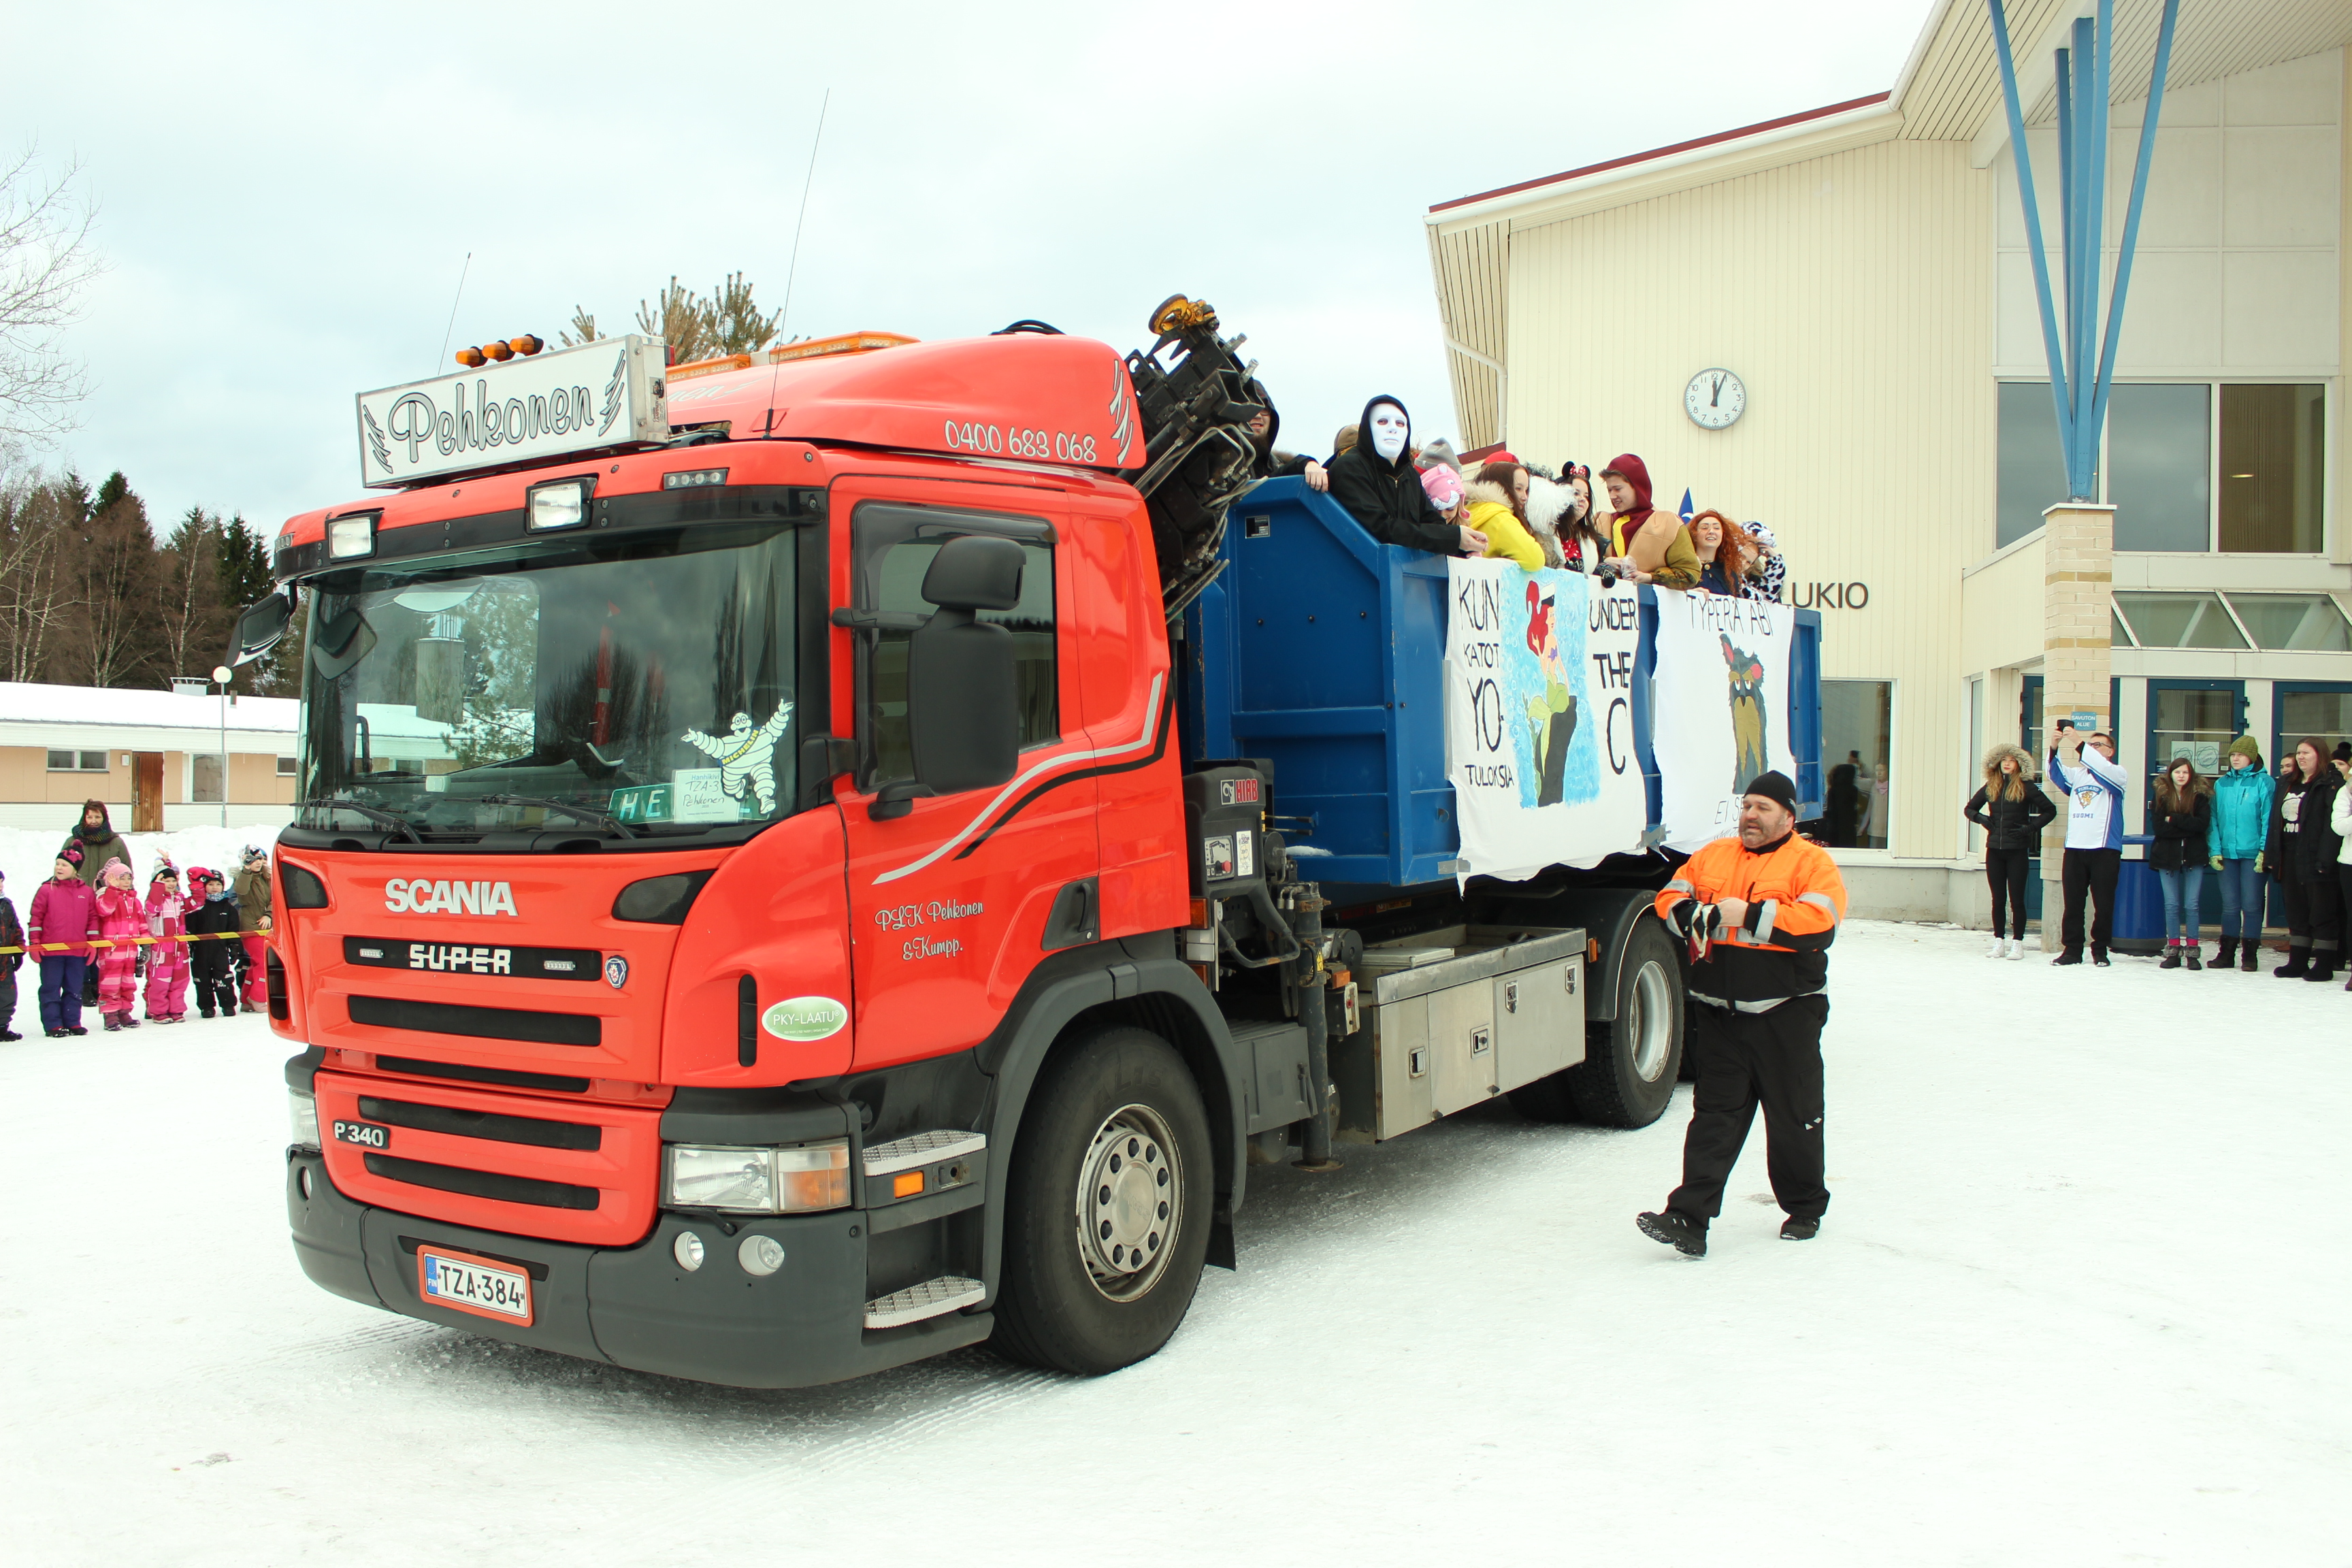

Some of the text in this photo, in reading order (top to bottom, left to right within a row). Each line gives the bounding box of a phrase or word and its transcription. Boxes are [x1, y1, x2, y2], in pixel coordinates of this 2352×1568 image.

[1692, 384, 1699, 392] 10
[1711, 372, 1718, 380] 12
[389, 380, 594, 463] Pehkonen
[1701, 414, 1708, 422] 7
[945, 419, 1097, 463] 0400 683 068
[1458, 575, 1499, 632] KUN
[1781, 582, 1869, 609] UKIO
[1588, 598, 1639, 632] UNDER
[1686, 594, 1774, 636] TYPERÄ ABI
[1463, 642, 1499, 668] KATOT
[1592, 651, 1631, 689] THE
[721, 729, 760, 765] MICHELIN
[1607, 697, 1627, 775] C
[685, 781, 719, 793] TZA-3
[1465, 764, 1514, 789] TULOKSIA
[619, 789, 665, 820] HE
[1235, 779, 1258, 804] HIAB
[1714, 800, 1729, 825] EI
[385, 879, 518, 916] SCANIA
[926, 898, 983, 923] Pehkonen
[410, 944, 511, 975] SUPER
[333, 1122, 385, 1147] P 340
[427, 1277, 437, 1288] FIN
[440, 1264, 521, 1309] TZA-384
